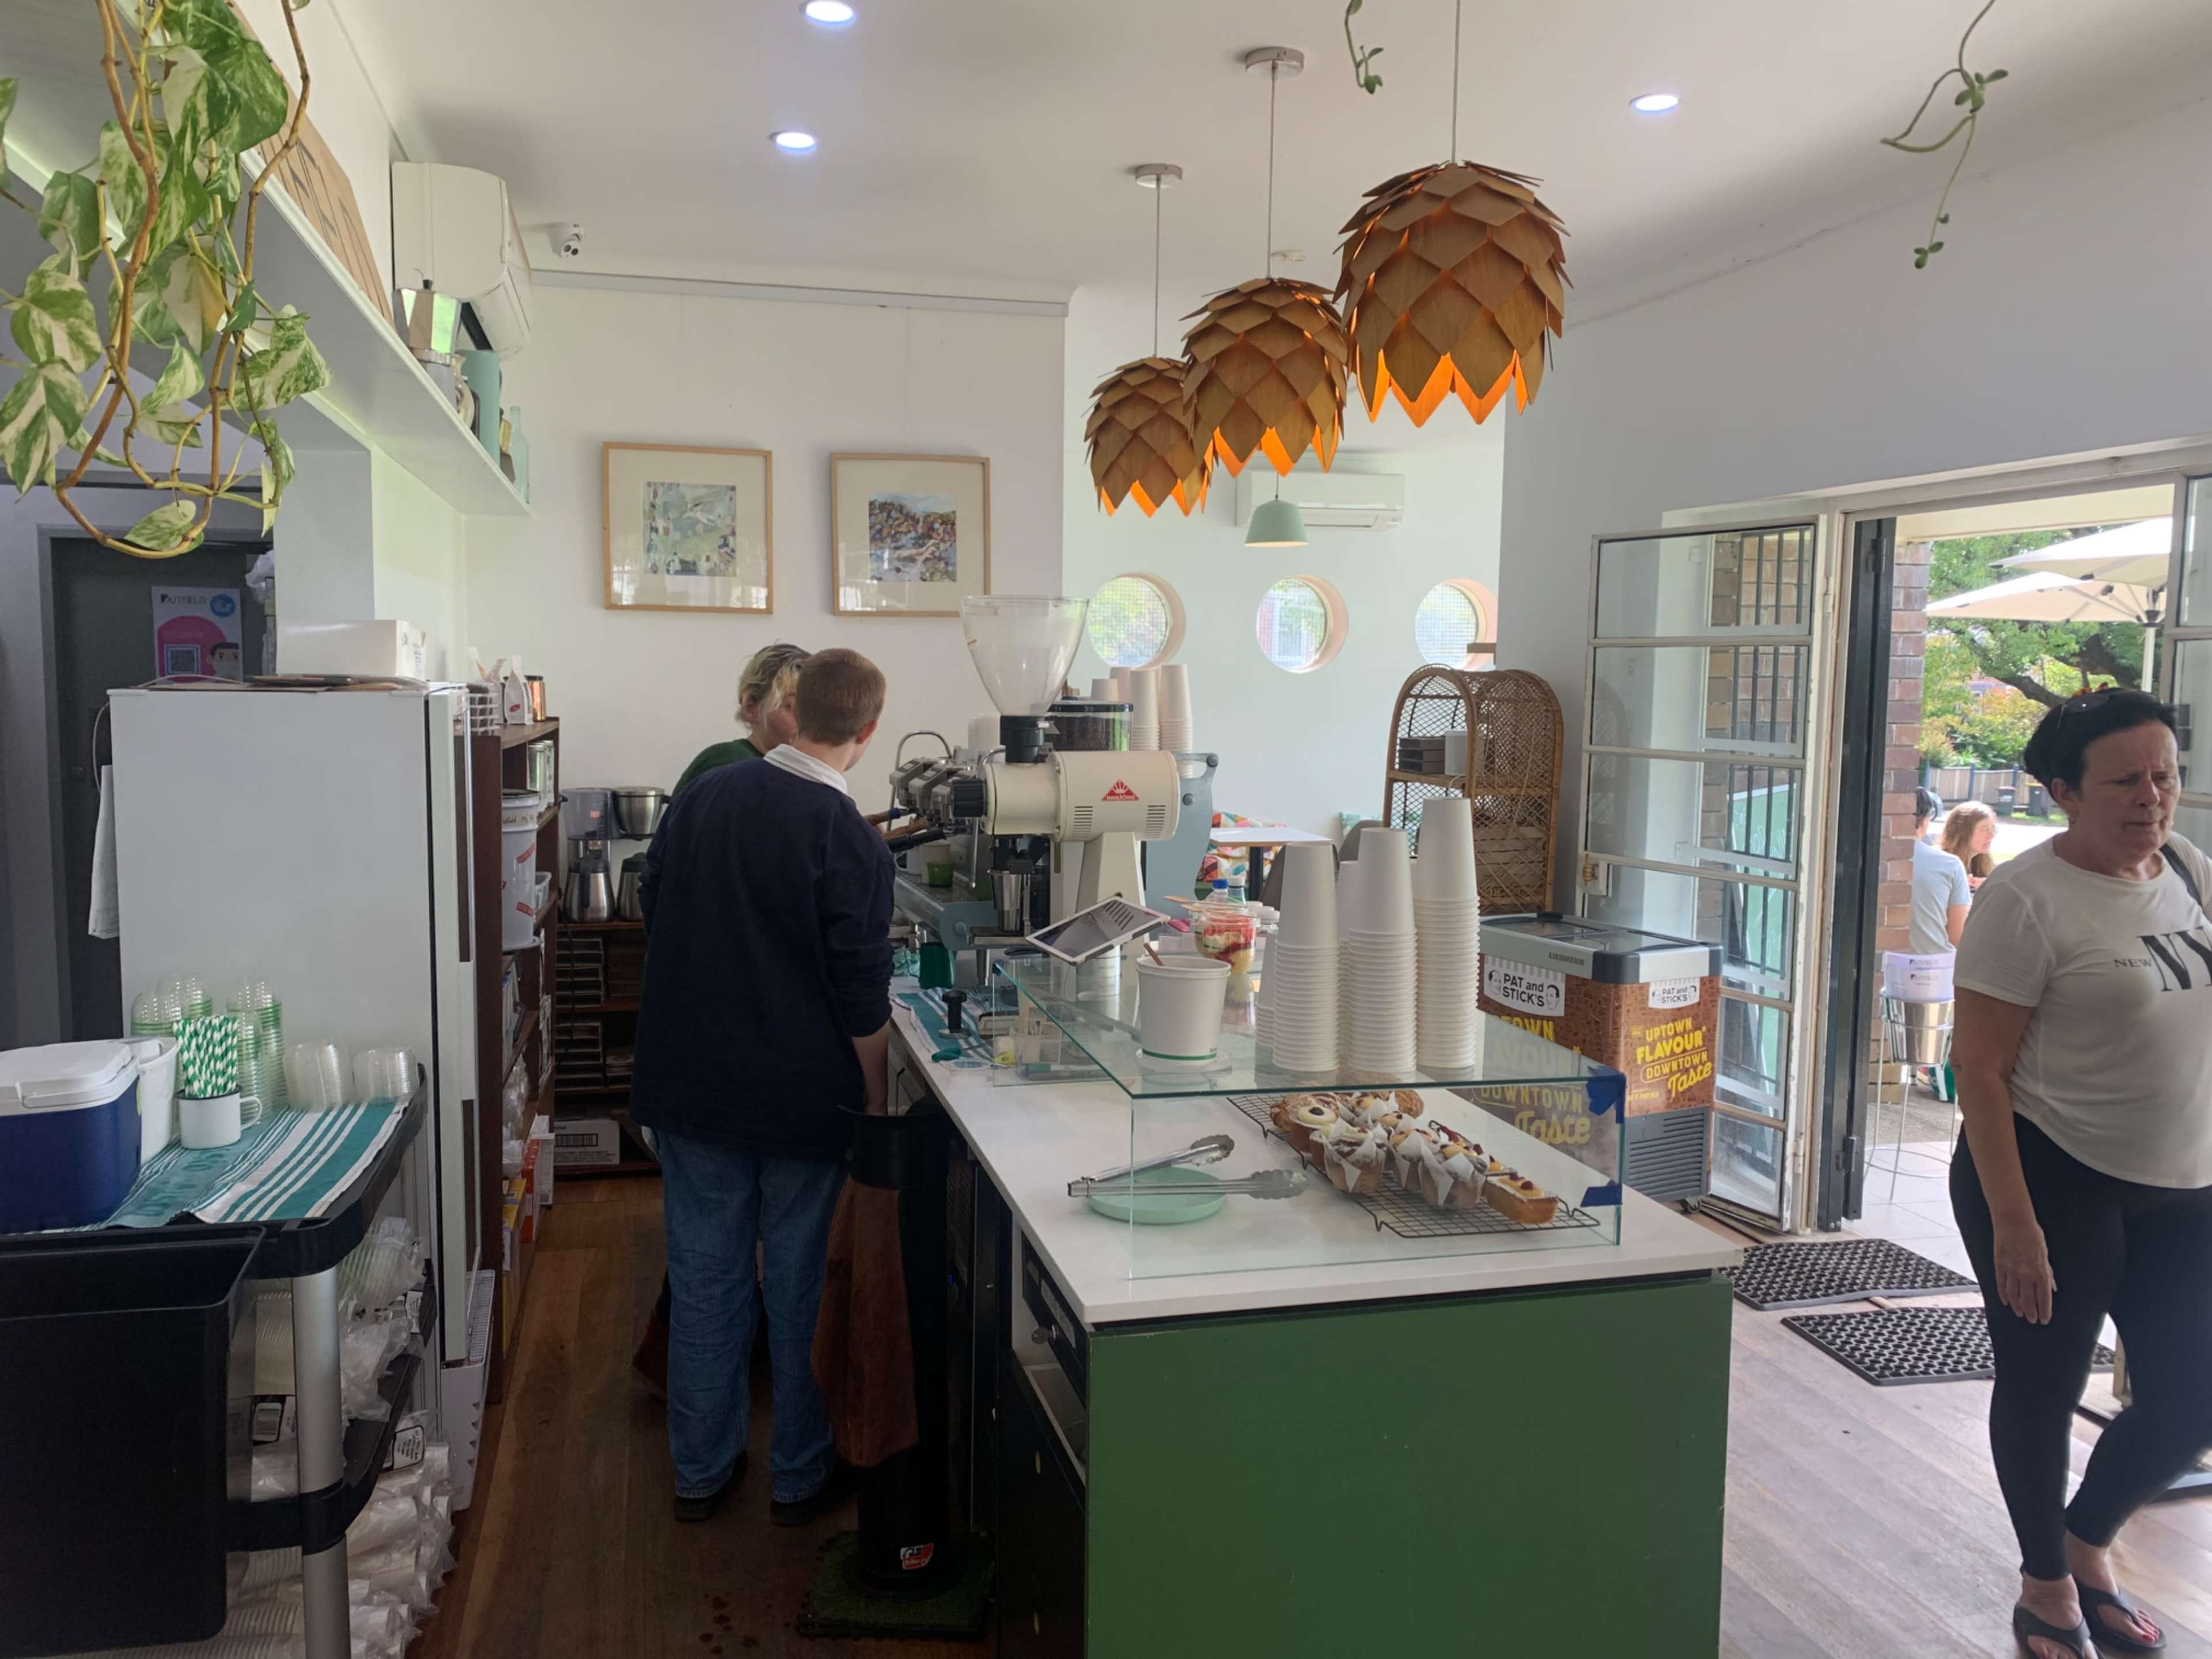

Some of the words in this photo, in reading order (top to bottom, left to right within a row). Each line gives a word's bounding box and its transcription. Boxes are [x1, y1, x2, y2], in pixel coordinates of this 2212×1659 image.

[2113, 959, 2152, 968] NEW
[1502, 986, 1544, 1007] STICK'S
[1504, 974, 1524, 988] PAT
[1526, 982, 1544, 993] and
[1646, 1017, 1692, 1042] UPTOWN
[1646, 1051, 1707, 1080] DOWNTOWN
[1668, 1062, 1712, 1097] Taste
[1480, 1085, 1582, 1114] DOWNTOWN
[1514, 1111, 1591, 1144] Taste
